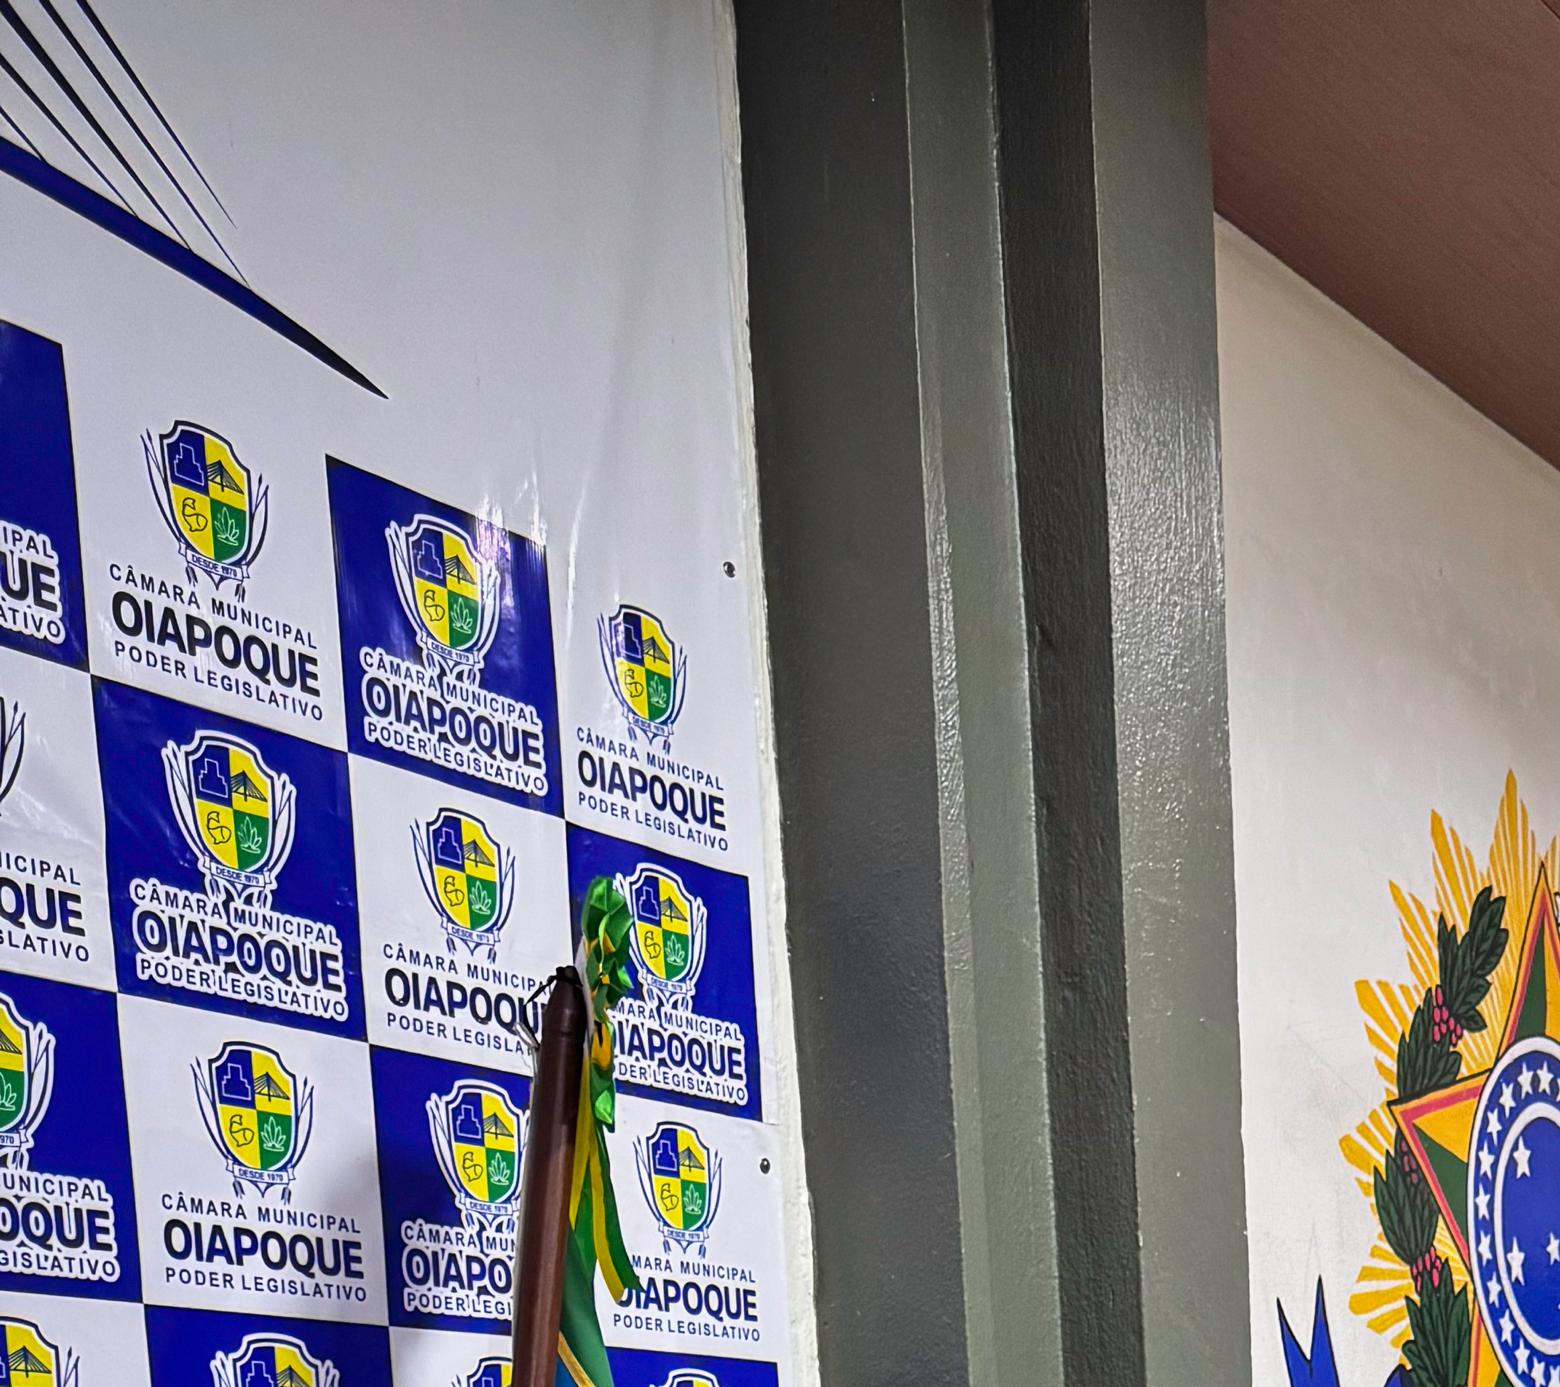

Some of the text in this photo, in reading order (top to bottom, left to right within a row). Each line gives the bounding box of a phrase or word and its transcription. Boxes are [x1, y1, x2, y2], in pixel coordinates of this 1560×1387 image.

[191, 553, 237, 580] DESDE 1970
[109, 563, 200, 609] CÂMARA
[211, 597, 316, 649] MUNICIPAL
[111, 591, 320, 697] OIAPOQUE
[114, 640, 322, 720] PODER LEGISLATIVO
[362, 652, 536, 725] CÂMARA MUNICIPAL
[364, 677, 539, 769] OIAPOQUE
[367, 722, 544, 790] PODER LEGISLATIVO
[573, 727, 722, 791] CÂMARA MUNICIPAL
[575, 749, 725, 831] OIAPOQUE
[577, 791, 729, 851] PODER LEGISLATIVO
[0, 850, 79, 885] ICIPAL
[215, 866, 260, 887] DESDE 1970
[134, 883, 337, 946] CÂMARA MUNICIPAL
[136, 909, 340, 993] OIAPOQUE
[383, 942, 552, 997] CÂMARA MUNICIPA
[140, 958, 346, 1016] PODER LEGISLATIVO
[385, 967, 545, 1038] OIAPOQU
[387, 1011, 527, 1054] PODER LEGISLA
[614, 999, 739, 1041] MARA MUNICIPAL
[614, 1020, 742, 1081] IAPOQUE
[619, 1061, 746, 1101] DER LEGISLATIVO
[0, 1134, 15, 1147] 970
[2, 1172, 106, 1202] UNICIPAL
[238, 1167, 283, 1184] DESDE 1970
[160, 1191, 359, 1234] CÂMARA MUNICIPAL
[404, 1223, 477, 1249] CÂMARA
[0, 1248, 116, 1277] GISLATIVO
[162, 1217, 362, 1280] OIAPOQUE
[405, 1247, 512, 1294] OIAPO
[633, 1253, 755, 1283] MARA MUNICIPAL
[165, 1266, 367, 1302] PODER LEGISLATIVO
[407, 1291, 465, 1311] PODER
[615, 1313, 762, 1342] PODER LEGISLATIVO
